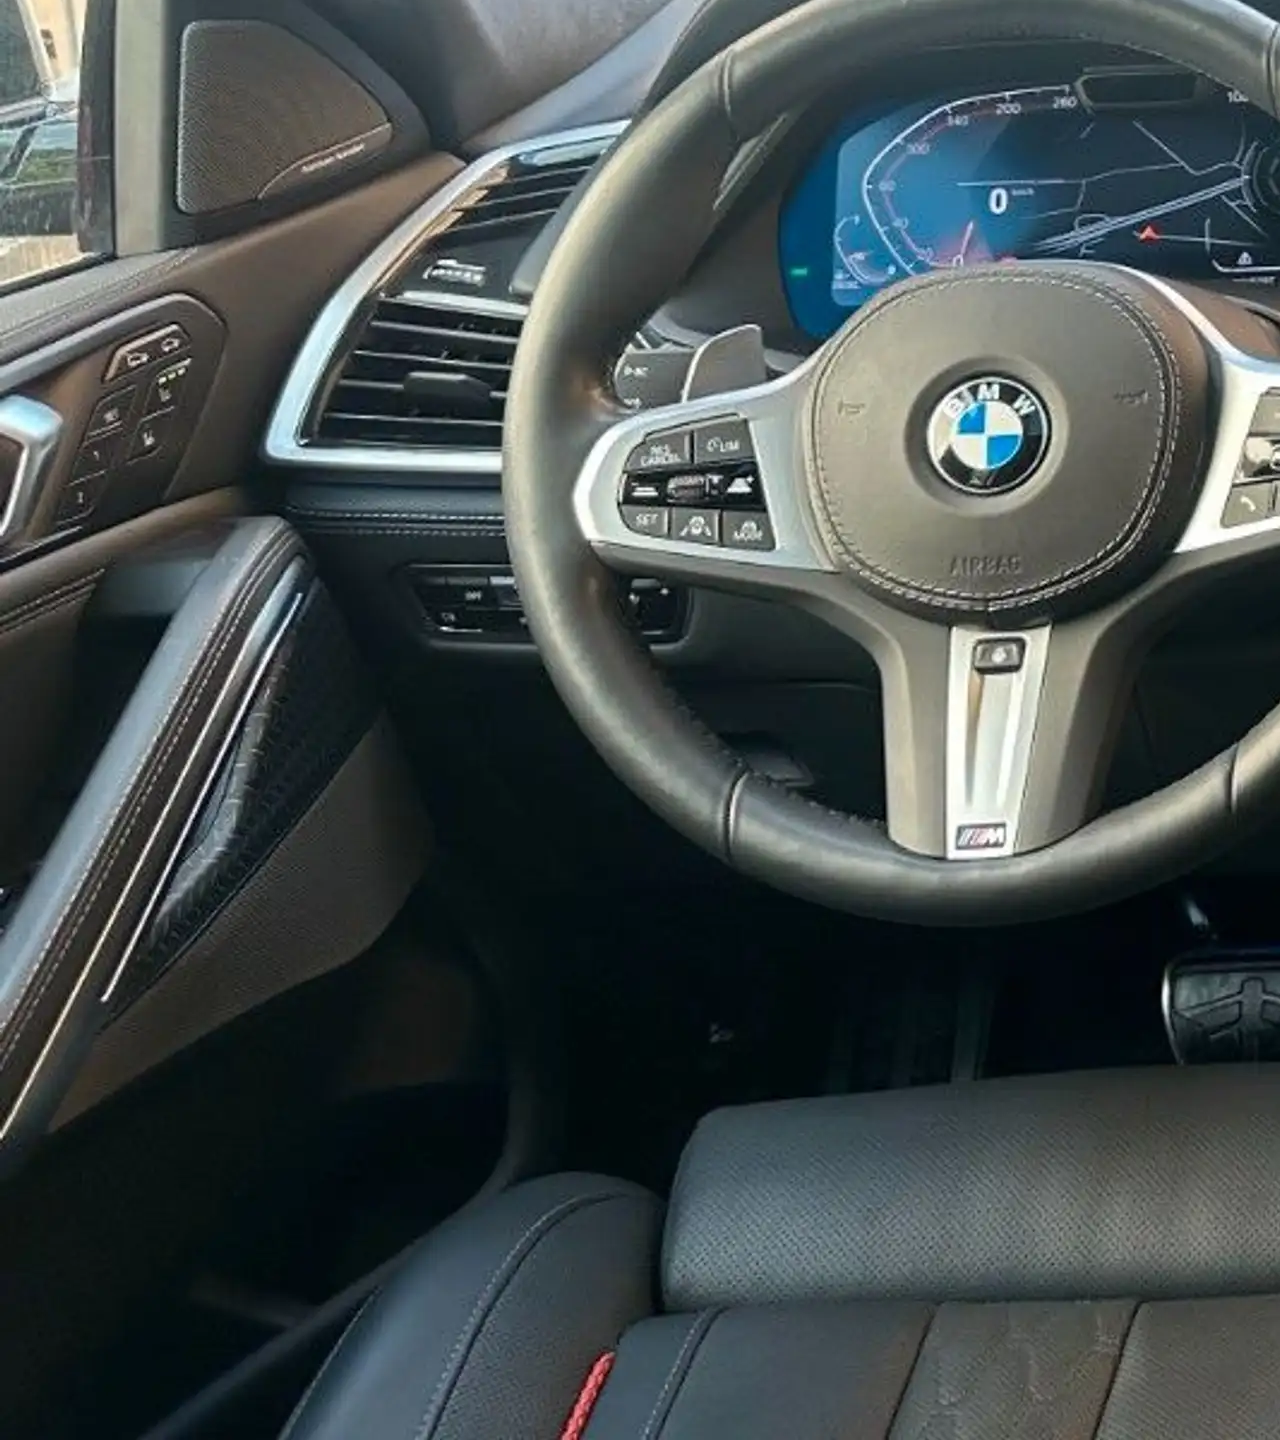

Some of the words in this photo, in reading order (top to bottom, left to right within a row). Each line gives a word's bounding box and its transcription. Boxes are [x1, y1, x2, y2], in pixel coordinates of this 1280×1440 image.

[996, 102, 1021, 115] 200
[989, 187, 1008, 215] 0
[942, 383, 1036, 418] BMW
[950, 556, 1022, 575] AIRBAG
